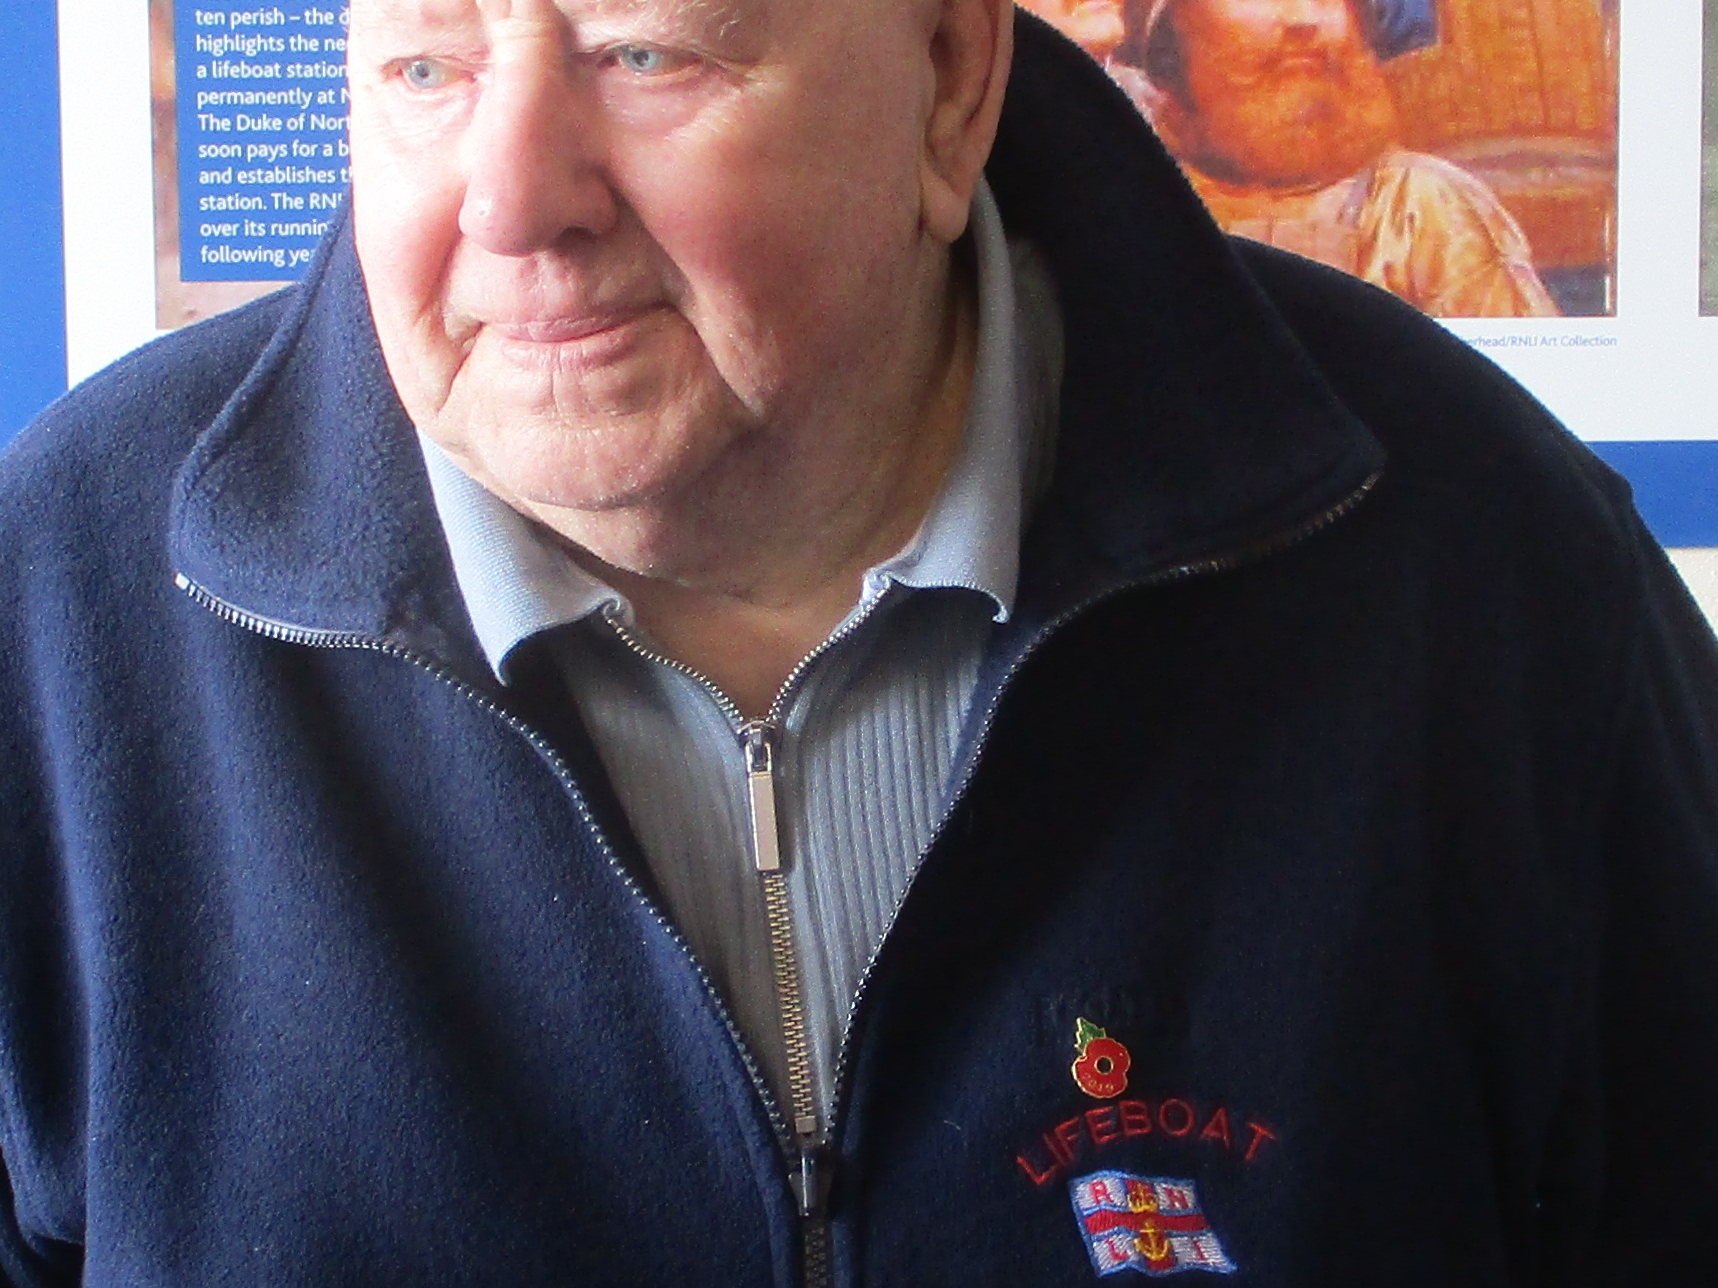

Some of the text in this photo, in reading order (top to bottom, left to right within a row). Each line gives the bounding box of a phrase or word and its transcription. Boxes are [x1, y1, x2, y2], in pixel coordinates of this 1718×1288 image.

[194, 6, 334, 30] ten perish the
[196, 33, 319, 56] highlights the
[196, 64, 207, 78] a
[212, 59, 281, 78] lifeboat
[197, 86, 335, 110] permanently at
[197, 112, 305, 131] The Duke of
[198, 138, 333, 162] soon pays for a
[198, 165, 335, 184] and establishes
[199, 192, 266, 210] station.
[270, 191, 304, 209] The
[199, 223, 239, 236] over
[244, 218, 266, 236] its
[200, 244, 285, 267] following
[1560, 334, 1618, 348] Collection
[1015, 1097, 1277, 1186] LIFEBOAT
